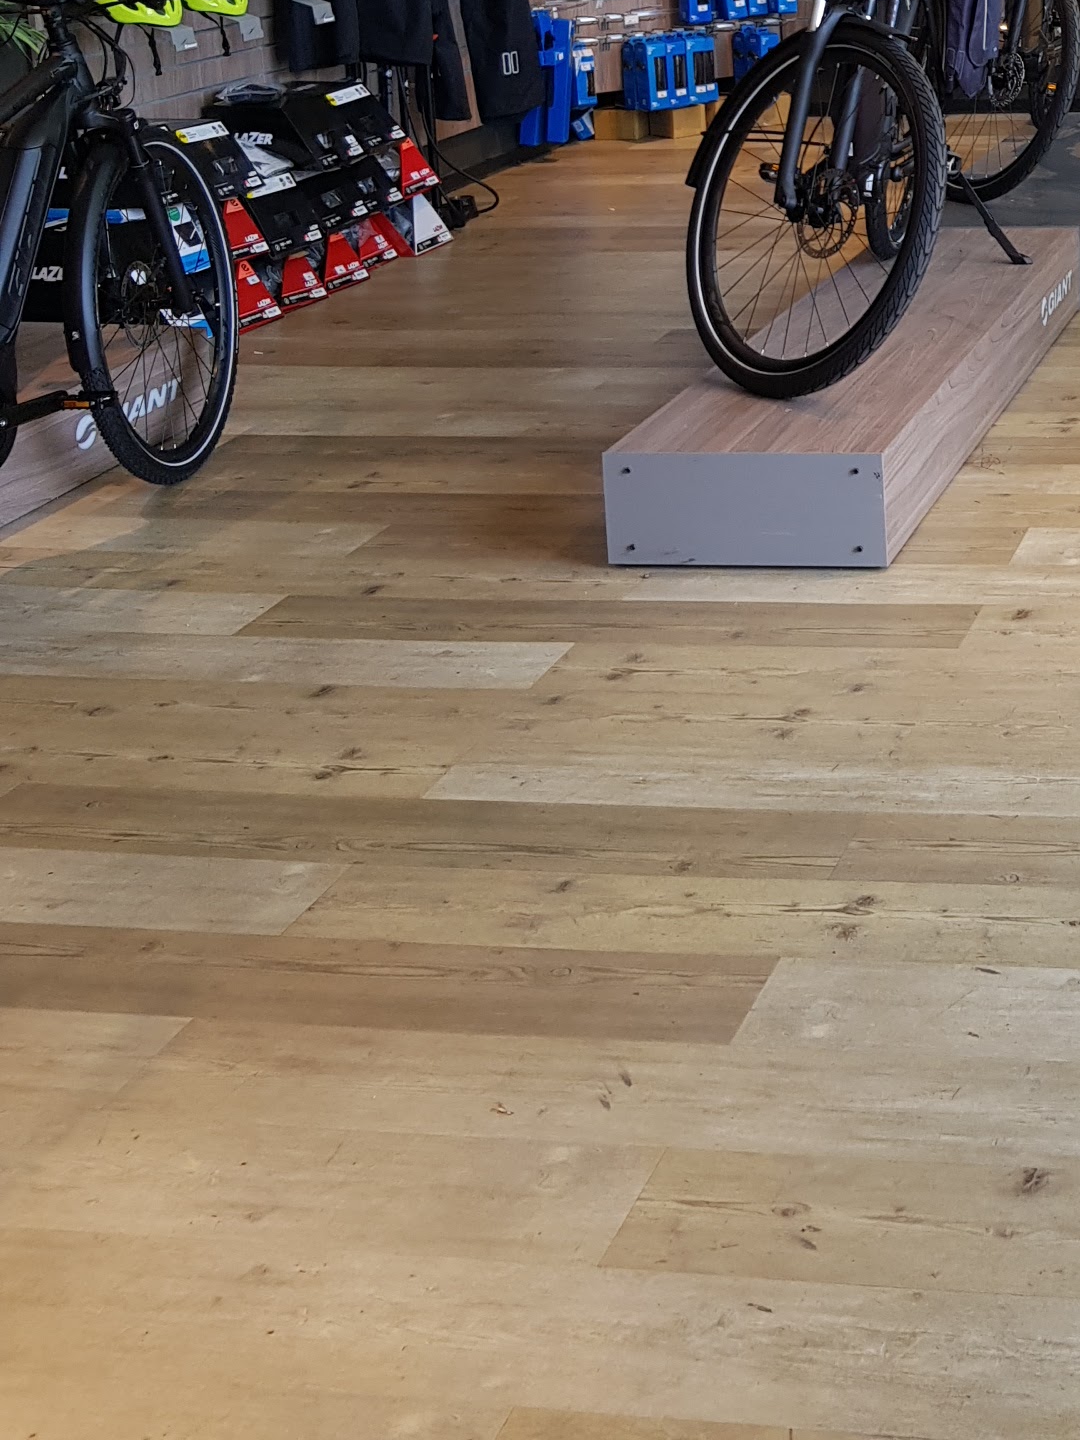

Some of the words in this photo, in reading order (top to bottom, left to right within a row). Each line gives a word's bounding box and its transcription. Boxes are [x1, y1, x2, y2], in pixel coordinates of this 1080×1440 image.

[234, 131, 273, 146] LAZER
[1047, 270, 1073, 316] GIANT
[122, 376, 181, 421] IANT
